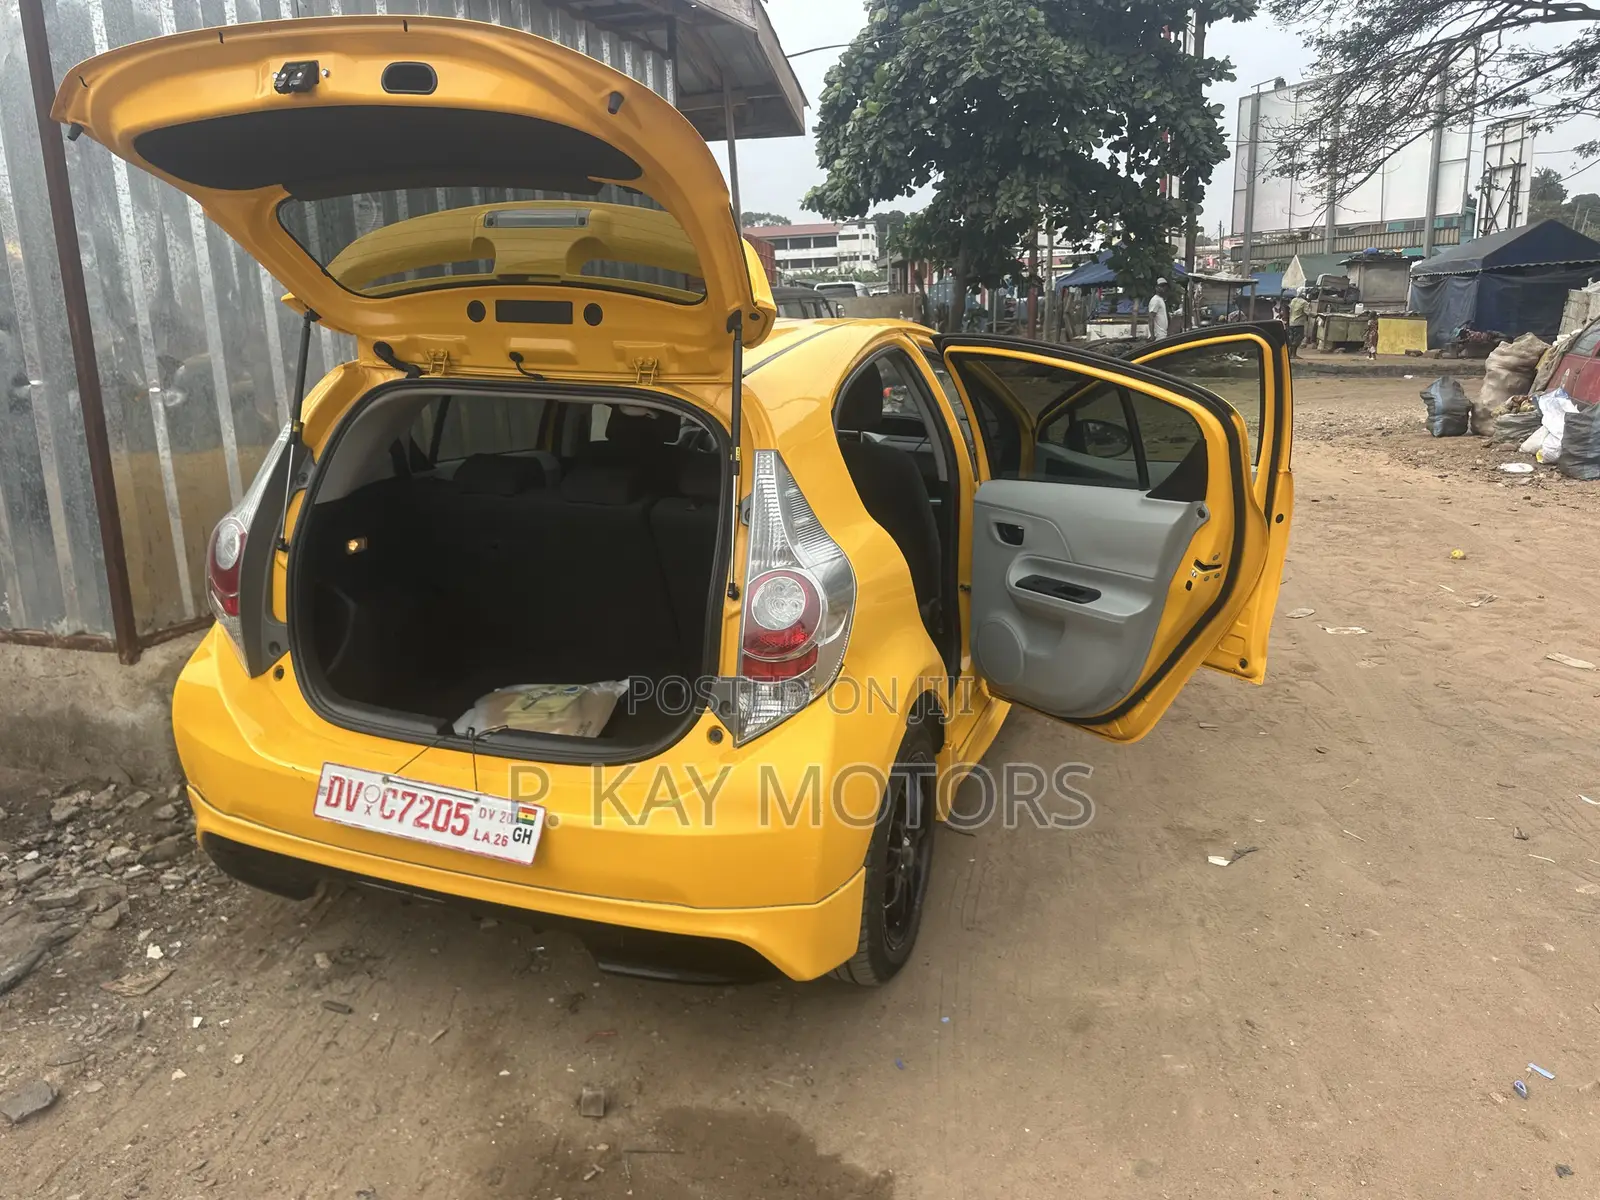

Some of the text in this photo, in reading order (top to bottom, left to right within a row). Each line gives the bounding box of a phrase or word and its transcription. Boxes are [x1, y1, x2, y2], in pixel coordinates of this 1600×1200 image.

[325, 775, 475, 837] DV C7205
[479, 806, 496, 821] DV
[512, 826, 533, 845] GH
